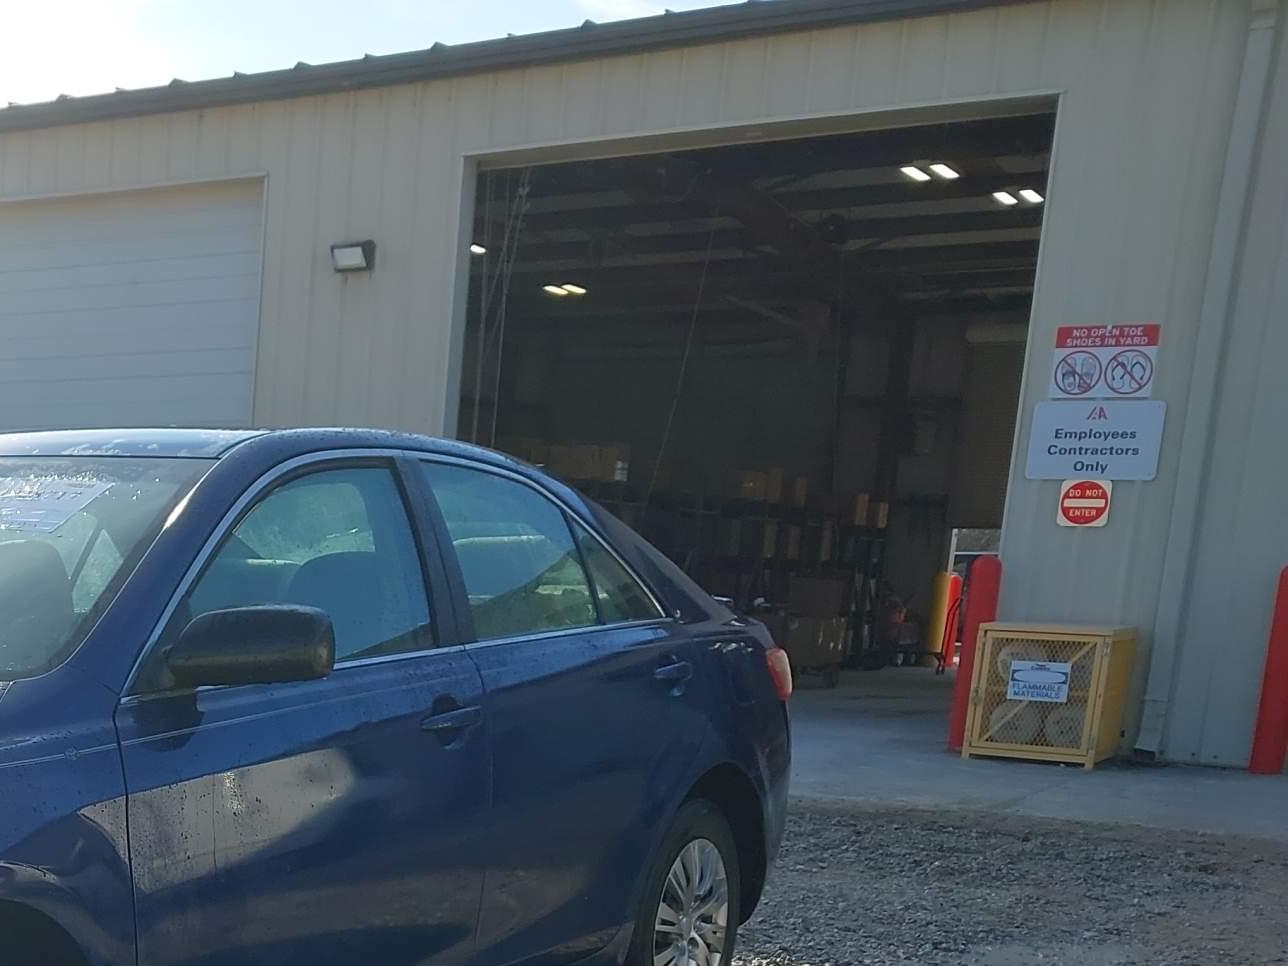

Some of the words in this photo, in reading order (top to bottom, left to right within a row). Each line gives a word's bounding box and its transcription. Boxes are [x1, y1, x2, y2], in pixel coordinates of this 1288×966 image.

[1073, 328, 1088, 336] NO
[1091, 327, 1120, 336] OPEN
[1124, 326, 1144, 335] TOE
[1066, 338, 1102, 346] SHOES
[1104, 337, 1116, 346] IN
[1120, 336, 1148, 345] YARD
[1054, 428, 1137, 442] Employees
[1047, 444, 1140, 456] Contractors
[1073, 460, 1109, 474] Only
[1069, 489, 1082, 497] DO
[1086, 489, 1103, 497] NOT
[1069, 509, 1097, 517] ENTER
[1012, 683, 1063, 692] FLAMMABLE
[1013, 690, 1061, 699] MATERIALS
